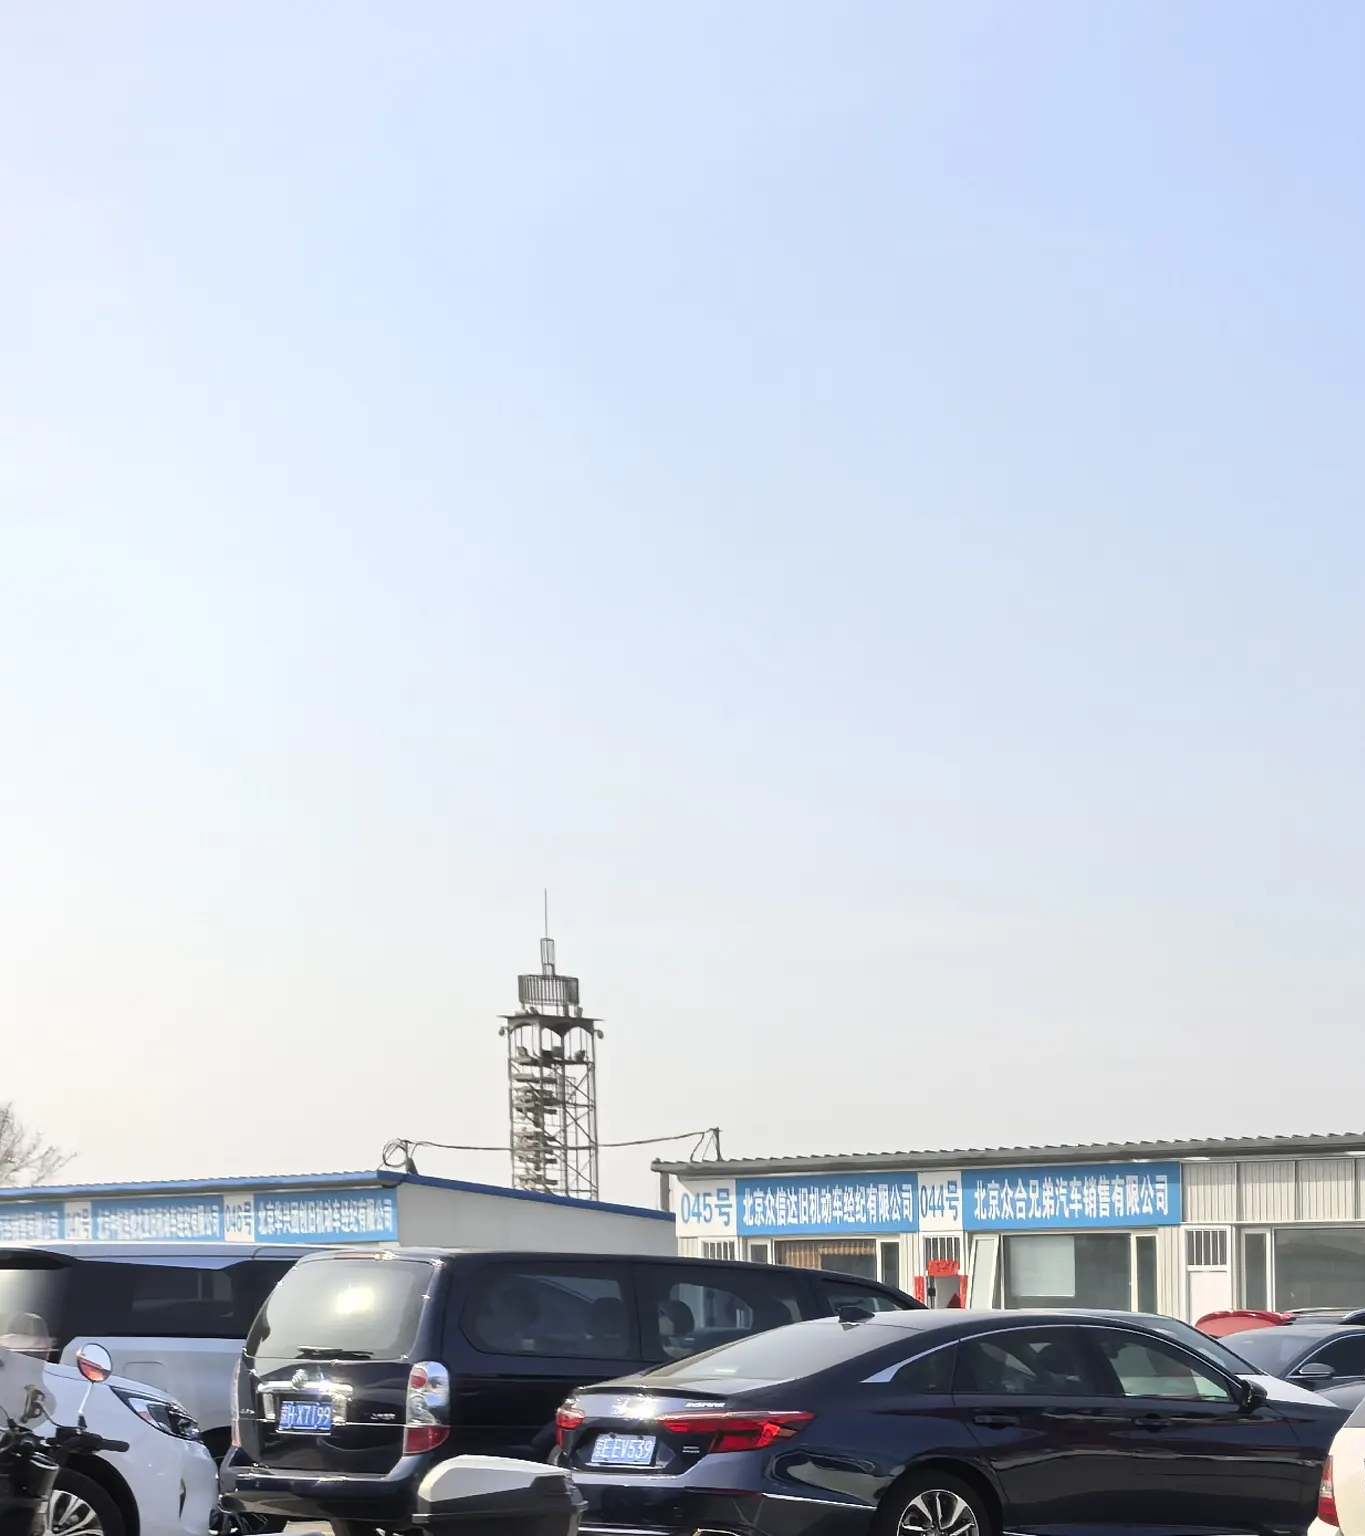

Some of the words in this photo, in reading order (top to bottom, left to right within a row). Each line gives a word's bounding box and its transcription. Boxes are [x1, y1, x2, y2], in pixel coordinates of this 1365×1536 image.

[681, 1187, 732, 1227] 045号
[742, 1183, 913, 1227] 北京众信达旧机动车经纪有限公司
[920, 1180, 961, 1222] 044号
[973, 1174, 1168, 1222] 北京众合兄弟汽车销售有限公司
